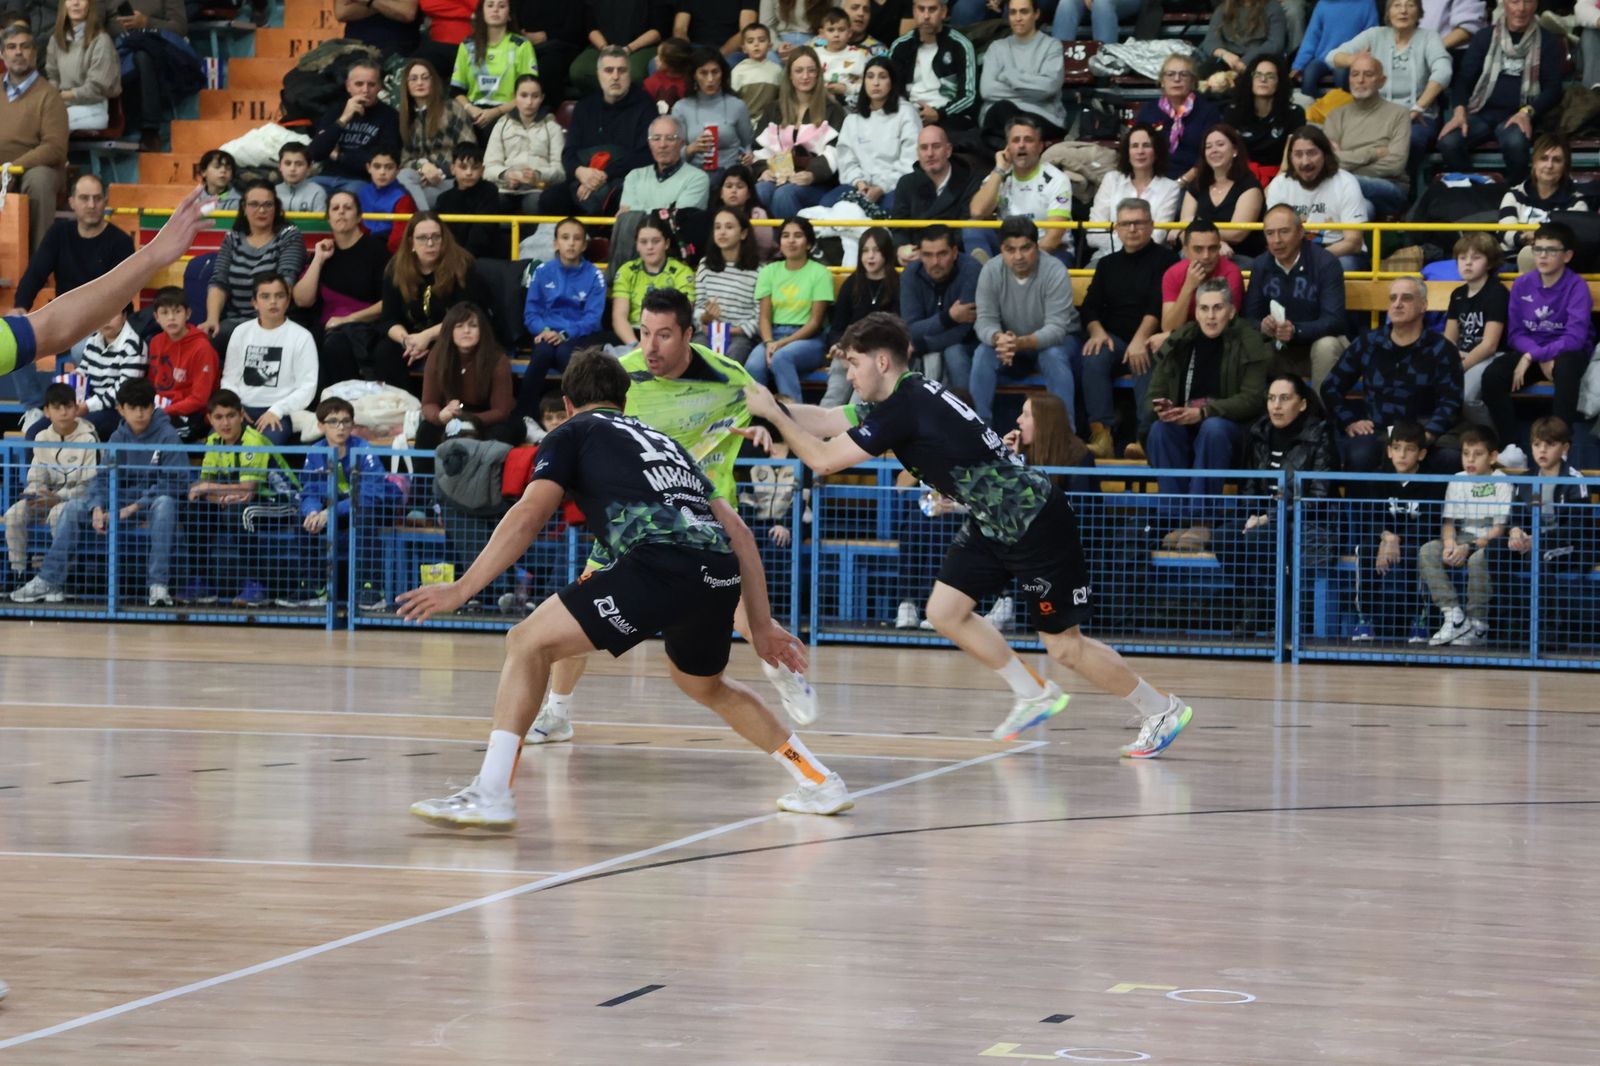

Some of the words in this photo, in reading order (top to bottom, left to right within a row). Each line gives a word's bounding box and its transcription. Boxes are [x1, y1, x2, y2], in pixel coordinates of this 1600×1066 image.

[612, 421, 691, 470] 13
[703, 573, 742, 588] ingemotio
[611, 615, 638, 634] AMAT
